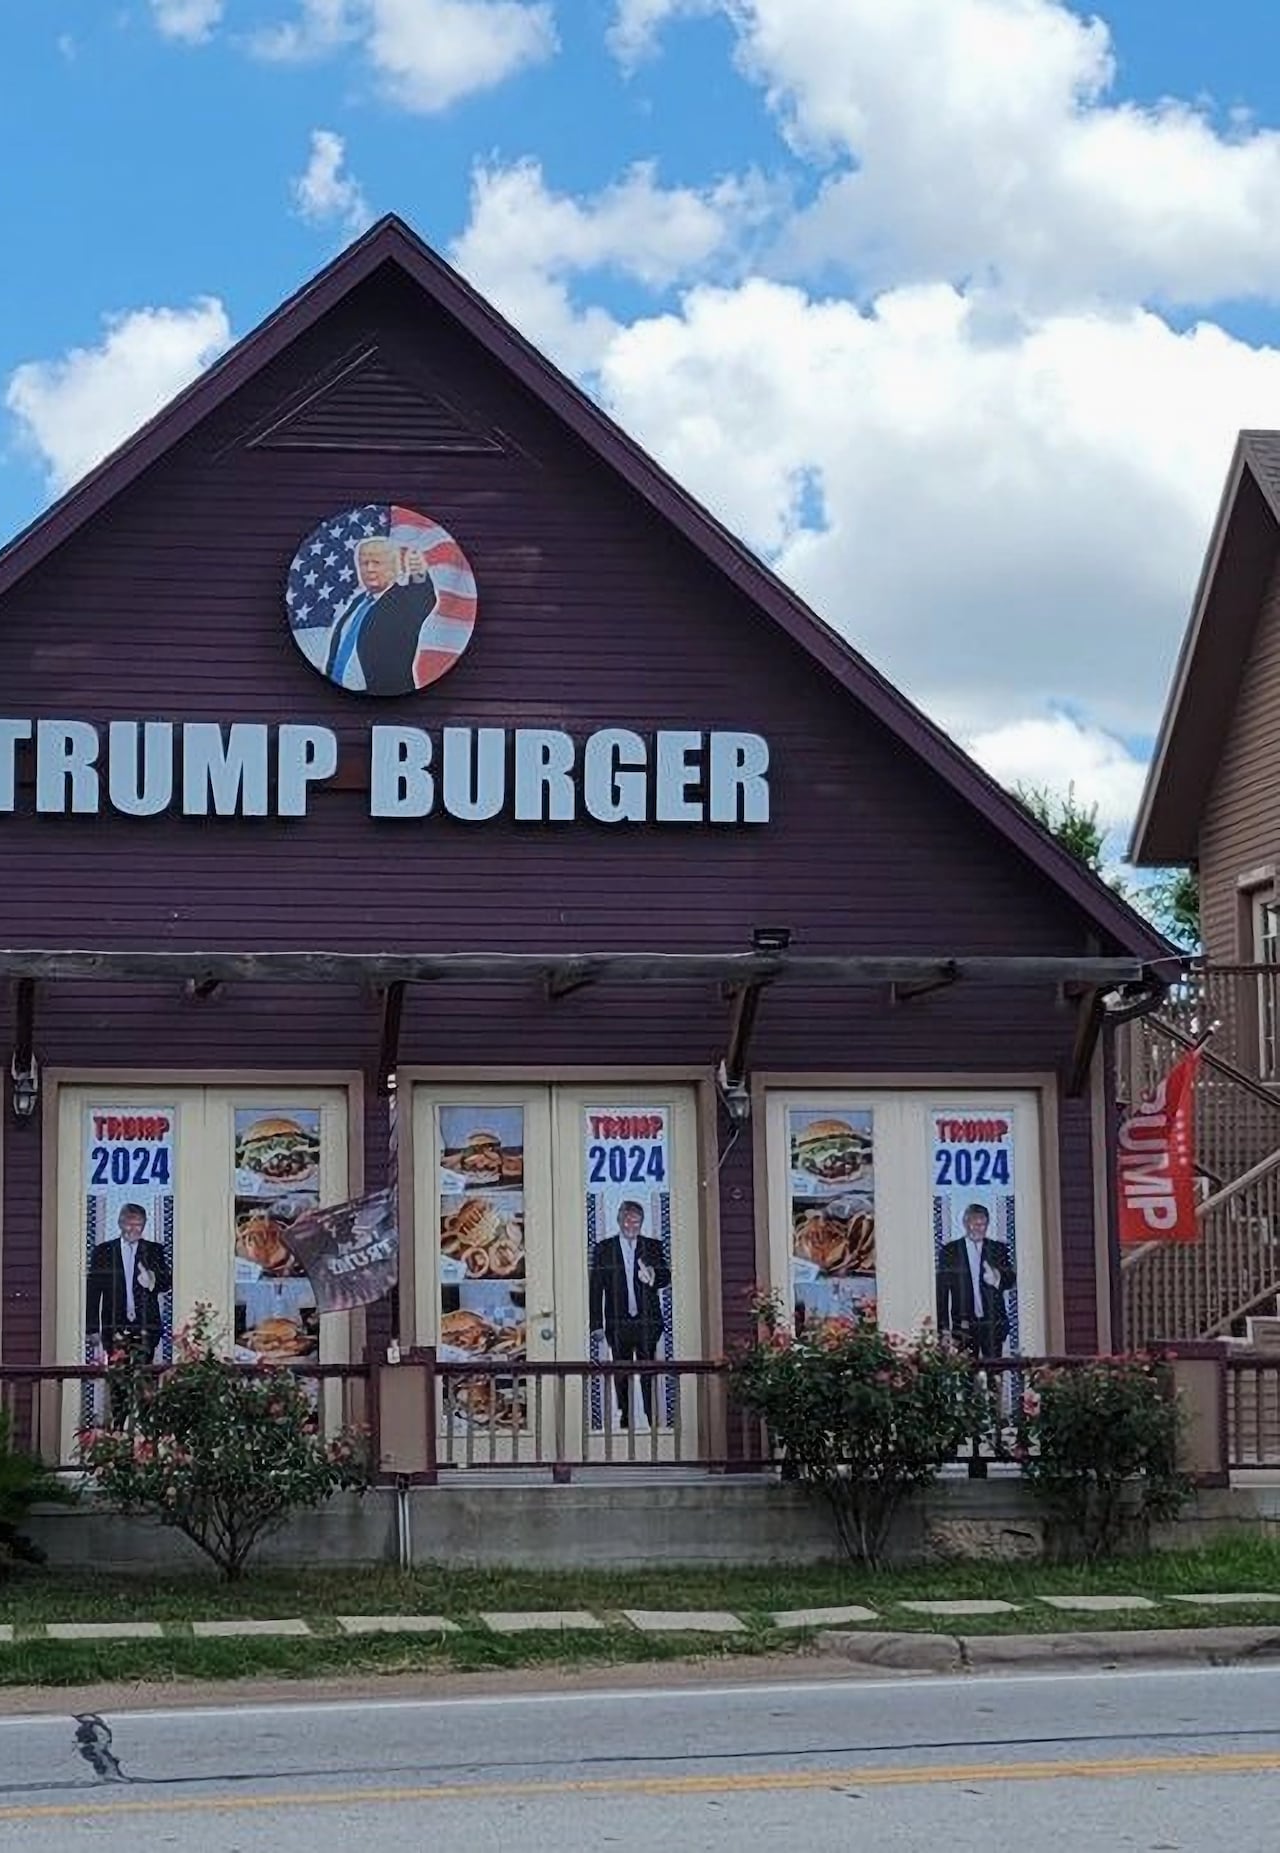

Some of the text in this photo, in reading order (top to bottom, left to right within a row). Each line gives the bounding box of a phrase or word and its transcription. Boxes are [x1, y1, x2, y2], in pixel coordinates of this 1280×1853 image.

[369, 723, 772, 825] BURGER
[92, 1115, 171, 1142] TRUMP
[589, 1115, 664, 1140] TRUMP
[935, 1118, 1009, 1143] TRUMP
[91, 1146, 170, 1185] 2024
[588, 1145, 665, 1184] 2024
[935, 1148, 1010, 1186] 2024
